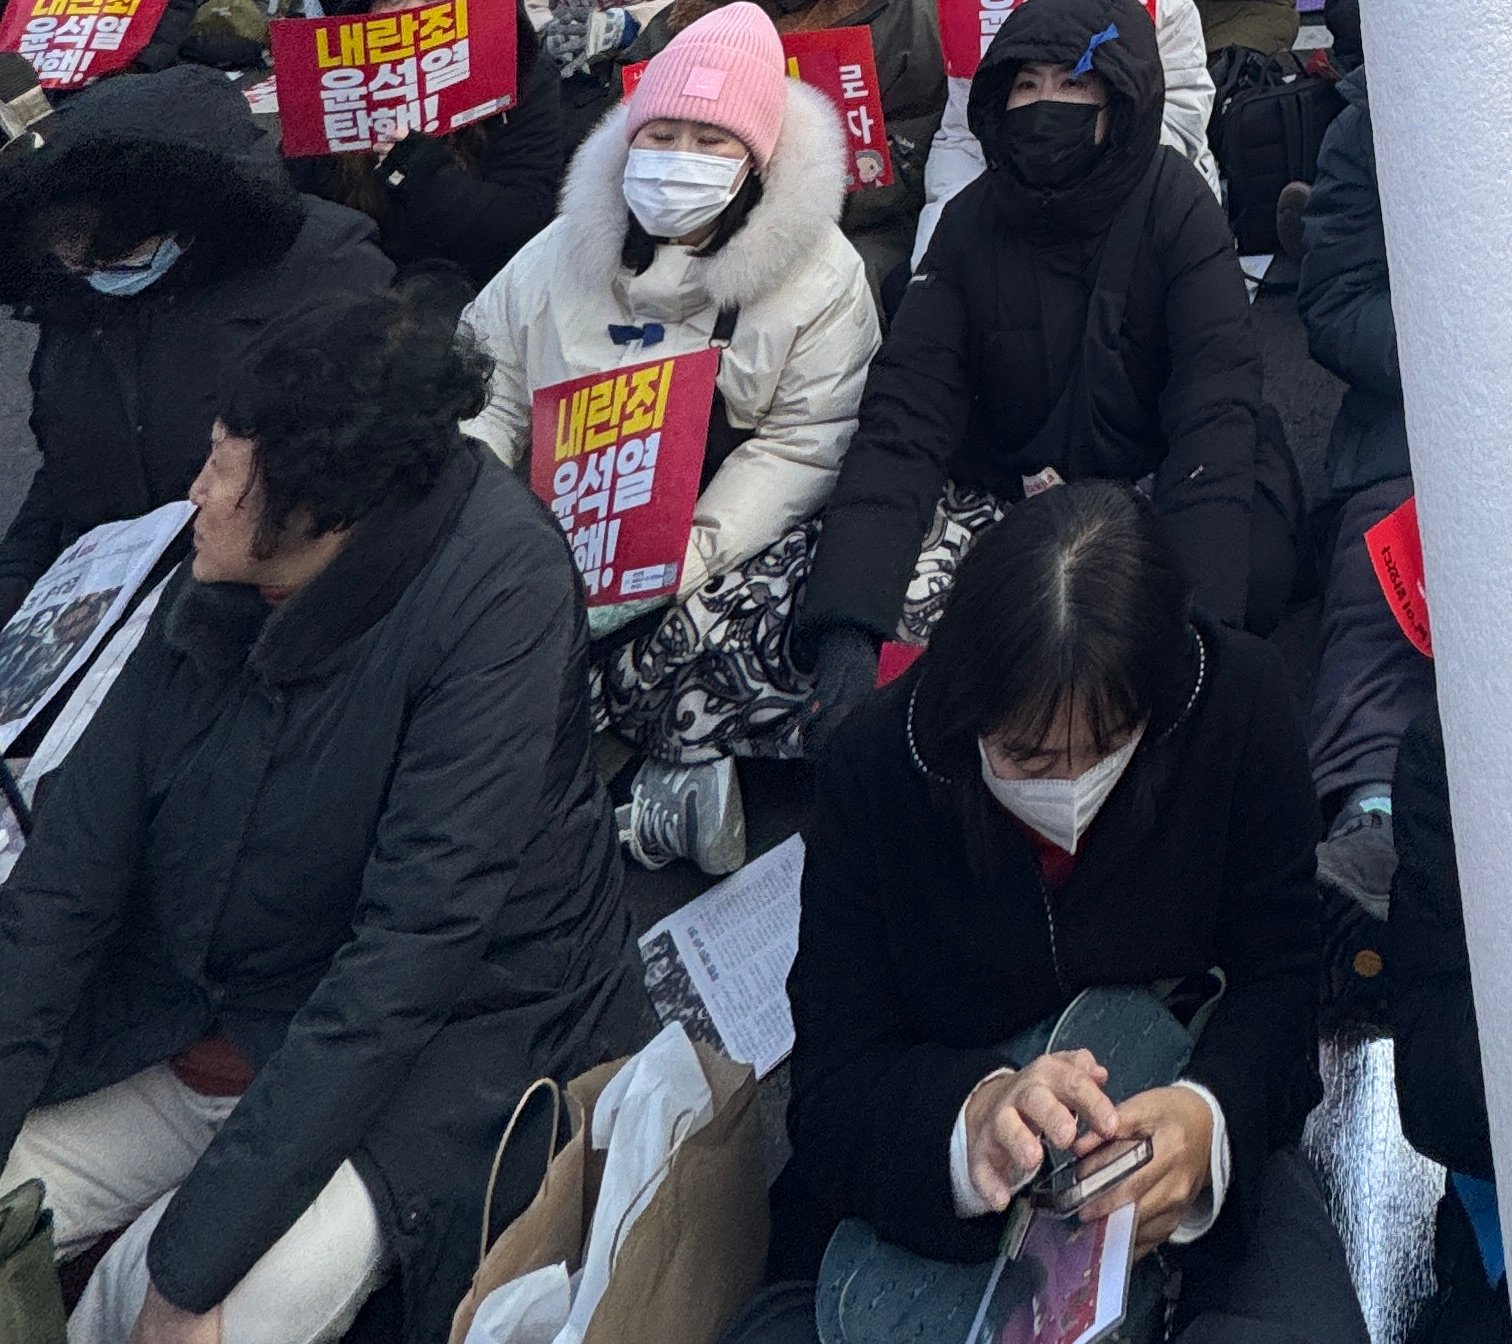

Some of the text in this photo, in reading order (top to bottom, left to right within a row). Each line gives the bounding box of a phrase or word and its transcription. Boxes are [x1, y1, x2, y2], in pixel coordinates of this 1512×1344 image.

[18, 14, 134, 53] 윤석열
[319, 37, 471, 113] 윤석열
[323, 94, 440, 154] 탄핵!
[554, 359, 676, 462] 내란죄
[551, 431, 661, 531] 윤석열
[566, 518, 622, 597] 핵!
